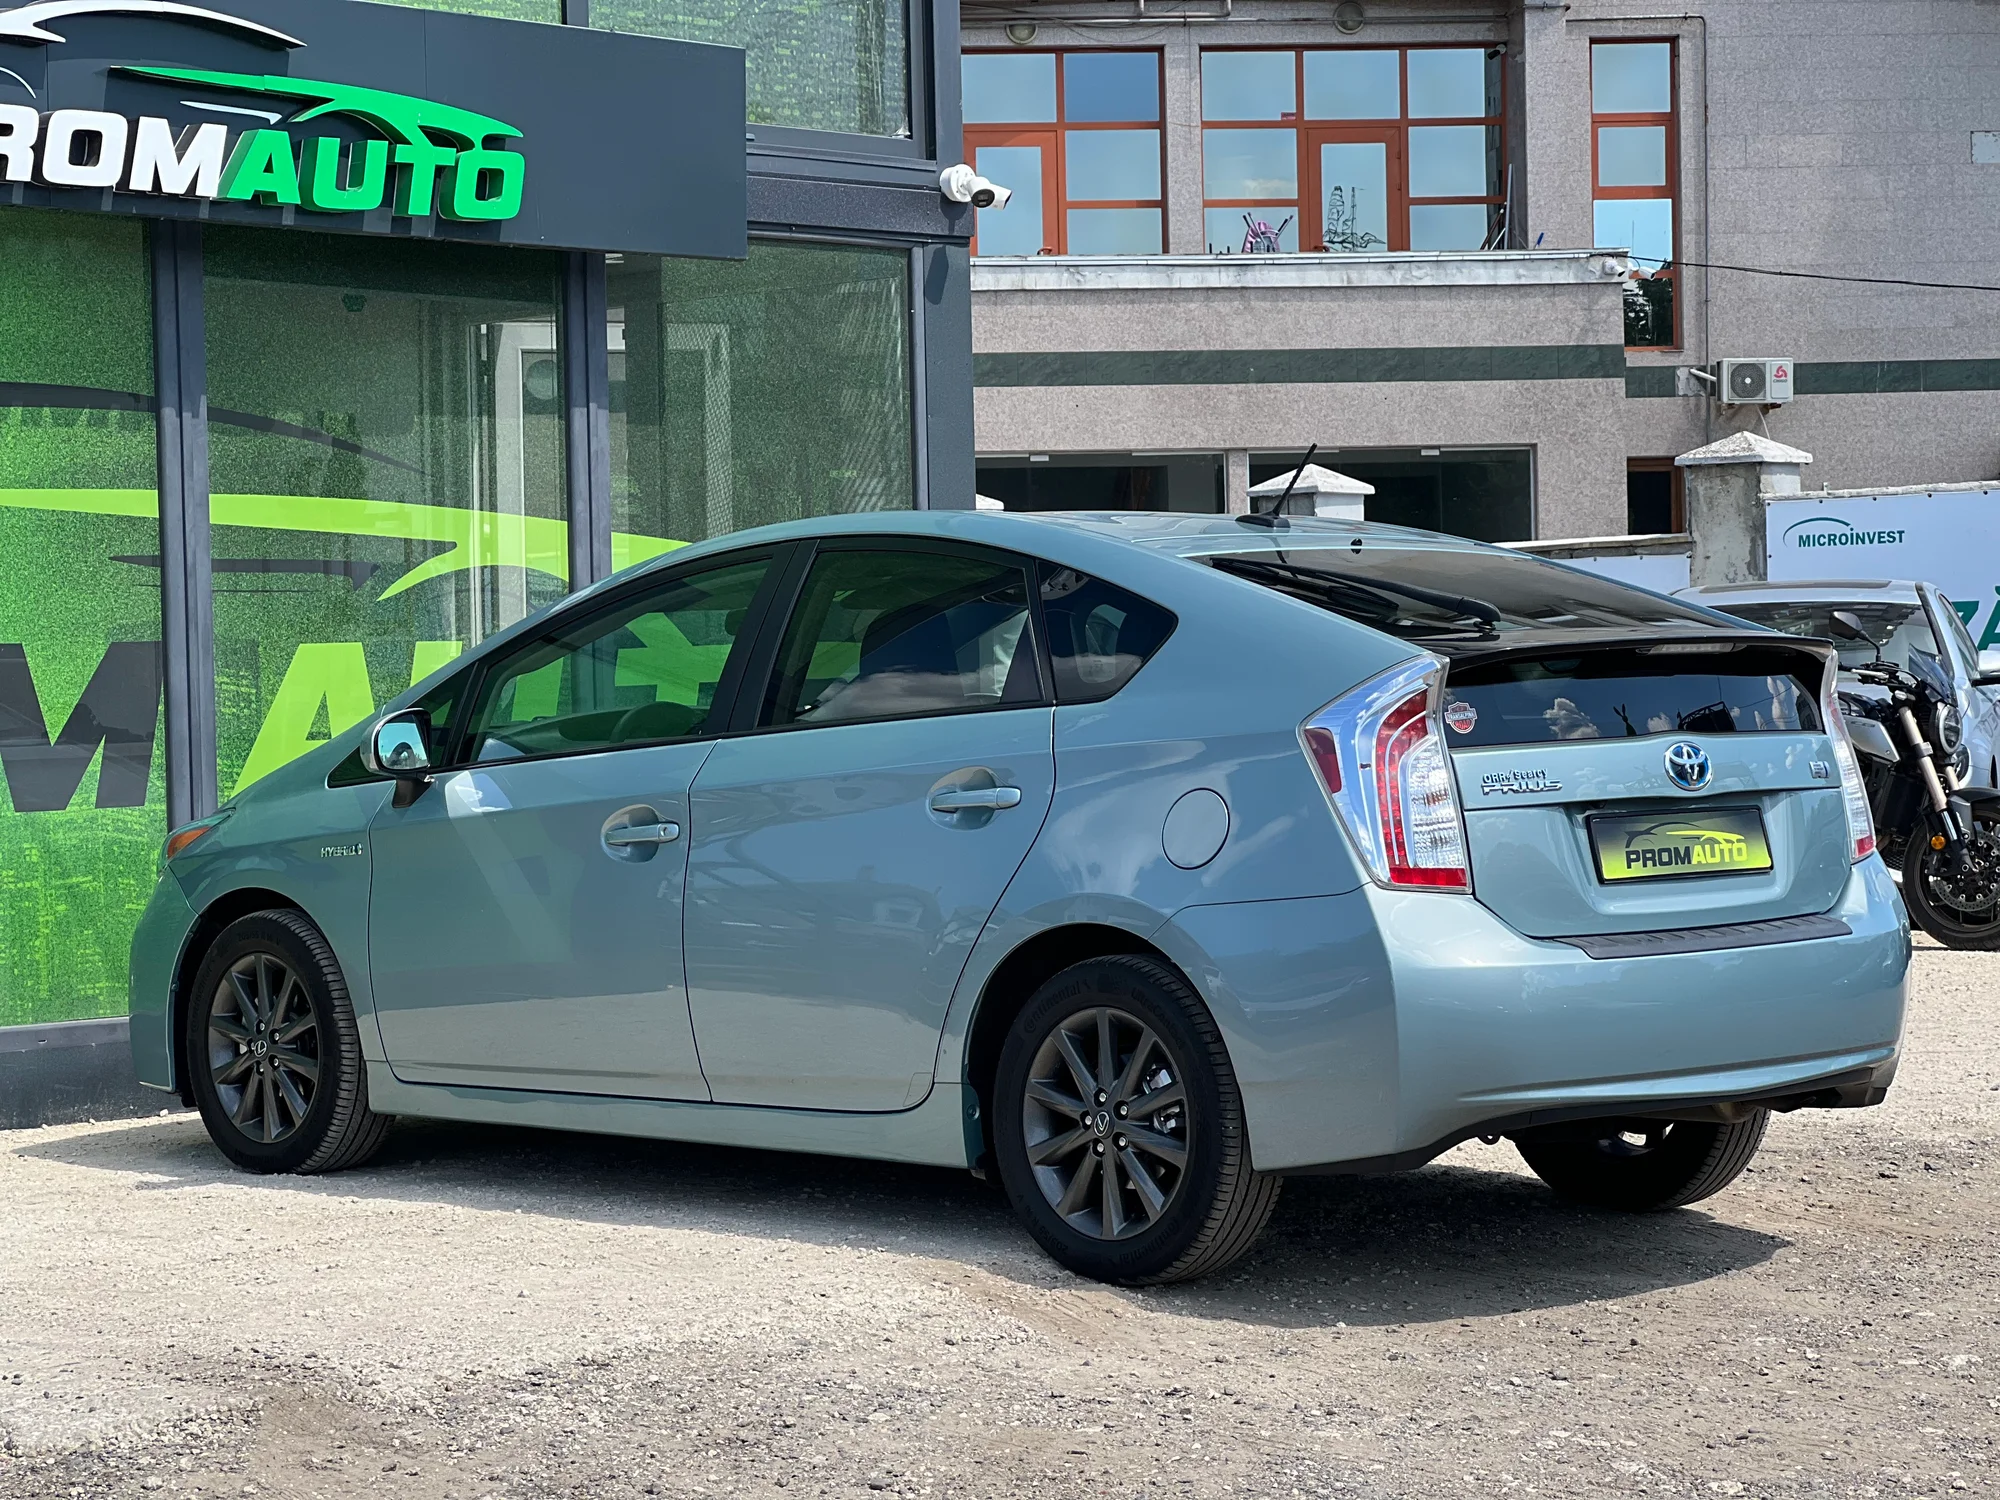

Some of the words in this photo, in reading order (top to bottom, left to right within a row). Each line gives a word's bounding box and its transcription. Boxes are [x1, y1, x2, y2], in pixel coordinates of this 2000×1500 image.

[1514, 768, 1548, 780] Searcy
[1481, 780, 1563, 796] PRIUS
[1625, 842, 1748, 869] PROMAUTO
[1024, 980, 1082, 1034] Continental
